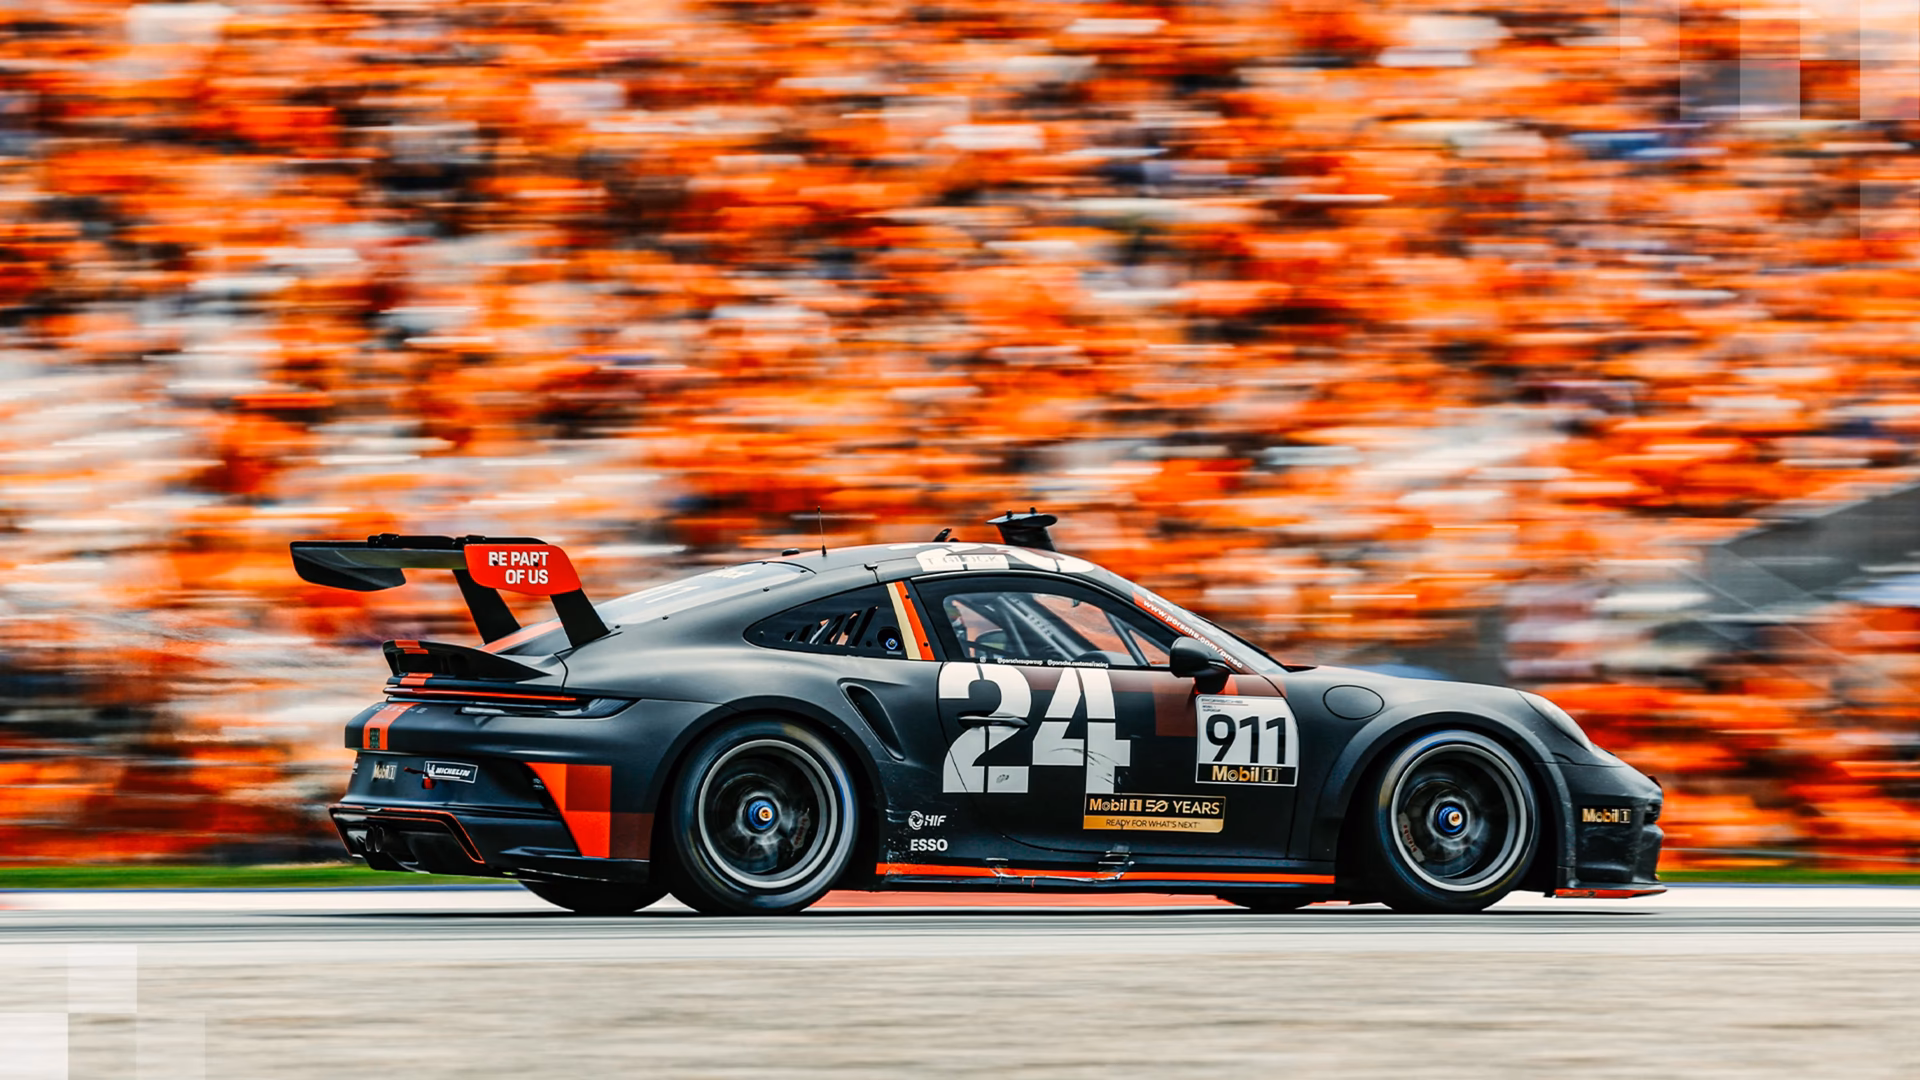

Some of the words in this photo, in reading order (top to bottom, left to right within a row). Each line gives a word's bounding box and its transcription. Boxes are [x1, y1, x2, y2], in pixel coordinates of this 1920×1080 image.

[488, 551, 508, 566] BE
[510, 551, 549, 566] PART
[505, 569, 525, 584] OF
[528, 569, 549, 584] US
[939, 661, 1131, 794] 24
[1205, 713, 1286, 765] 911
[435, 767, 471, 777] MICHELIN
[1211, 765, 1260, 782] Mobil
[1089, 798, 1127, 811] Mobil
[1129, 799, 1143, 811] 1
[1145, 800, 1169, 812] 50
[1173, 800, 1220, 815] YEARS
[924, 815, 947, 826] HIF
[1582, 808, 1619, 823] Mobil
[1106, 818, 1131, 827] READY
[1131, 819, 1147, 827] FOR
[1148, 820, 1177, 828] WHAT'S
[1177, 821, 1198, 829] NEXT
[910, 838, 948, 852] ESSO
